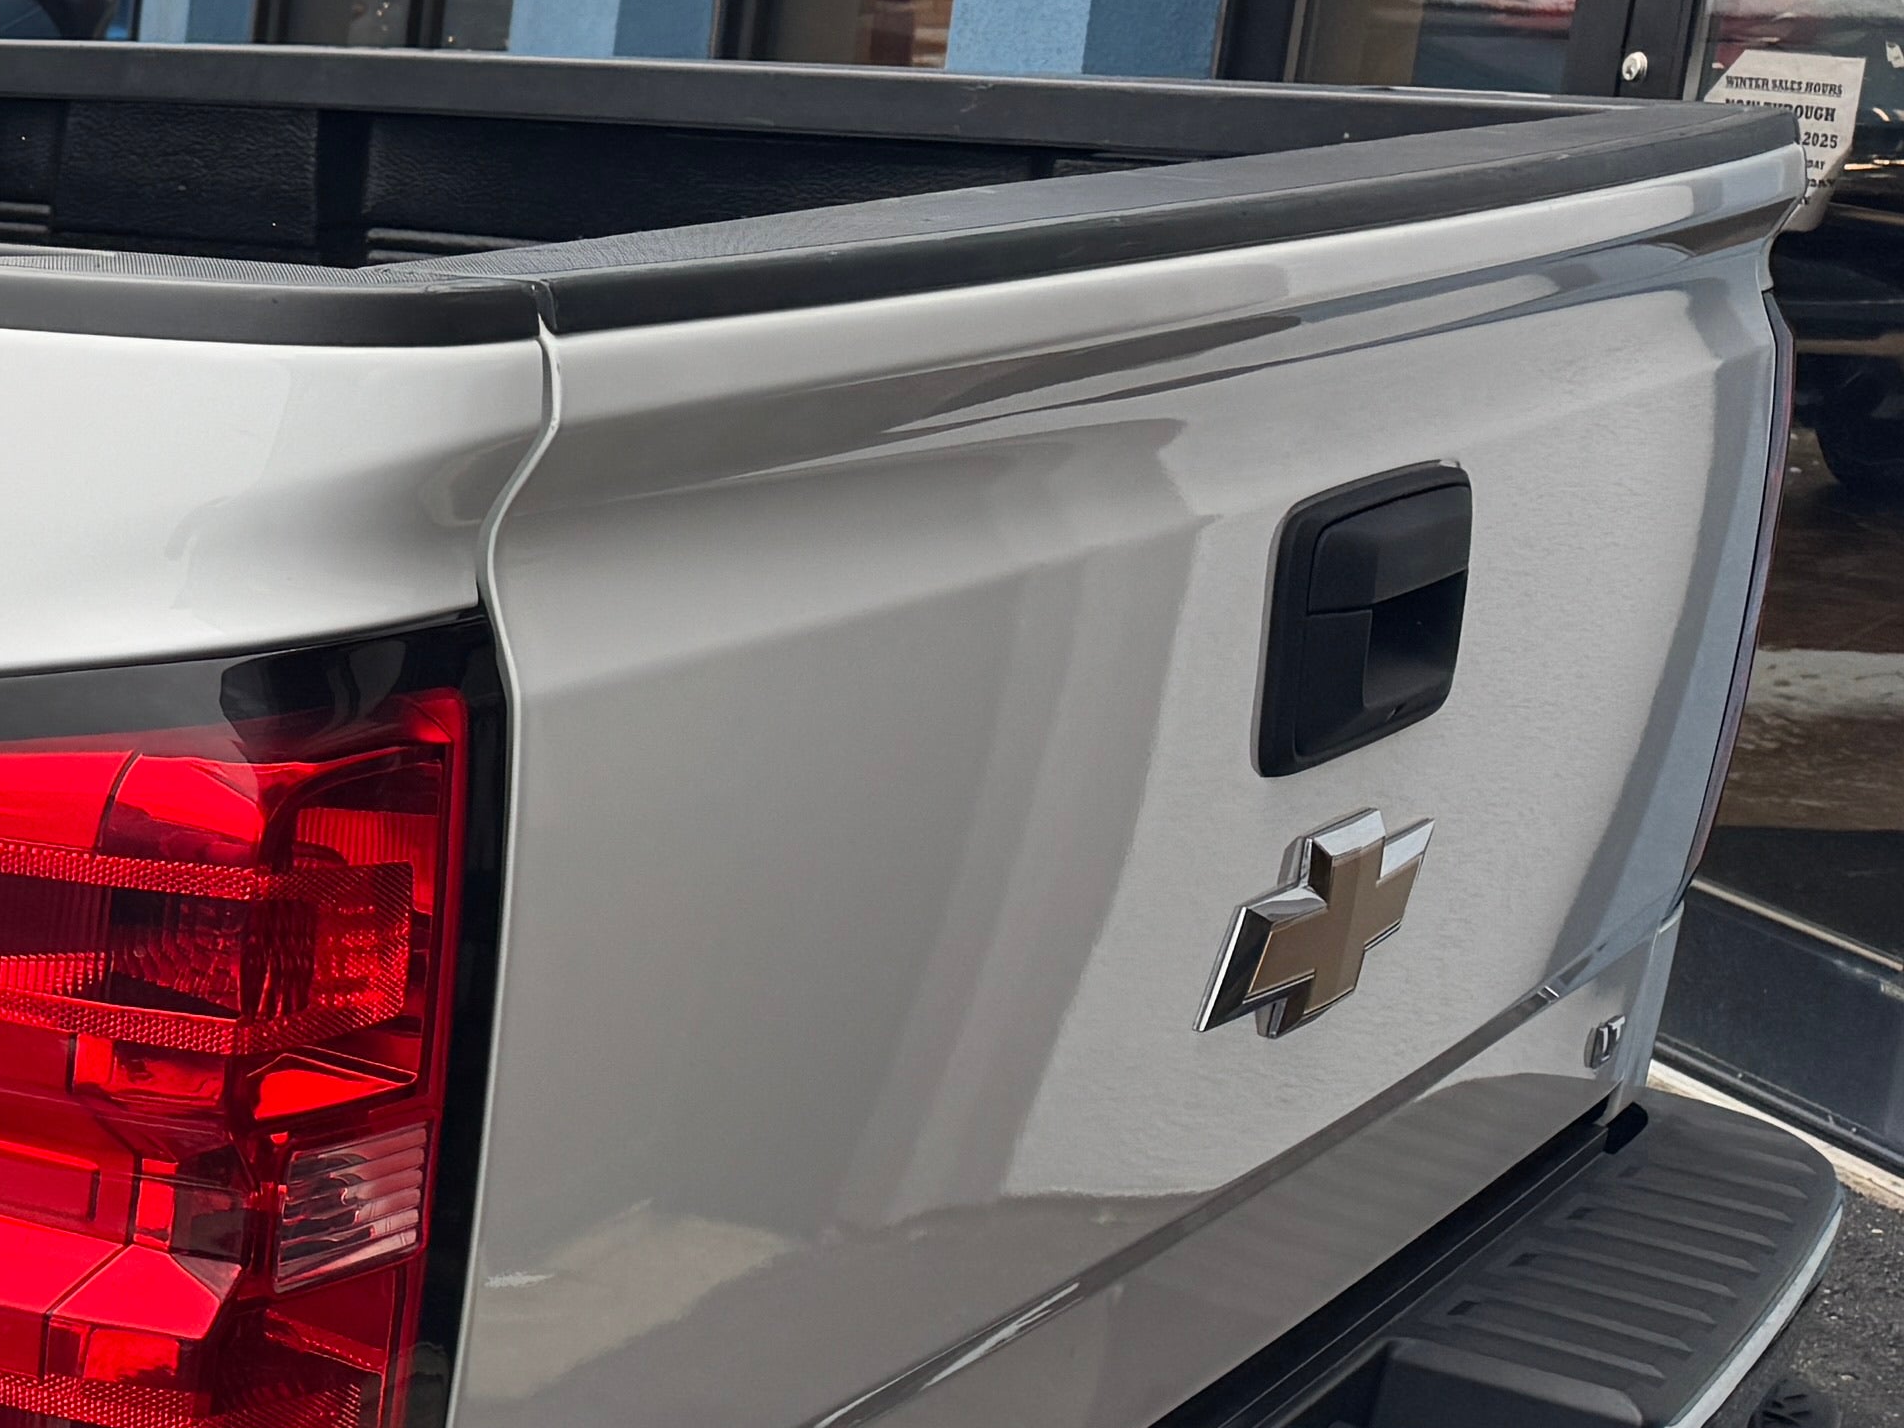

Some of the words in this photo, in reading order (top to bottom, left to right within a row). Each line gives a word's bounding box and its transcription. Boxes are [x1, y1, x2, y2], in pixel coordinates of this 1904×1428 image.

[1725, 74, 1770, 92] WINTER
[1771, 78, 1803, 93] SALES
[1804, 81, 1843, 98] HOURS
[1802, 131, 1839, 149] 2025
